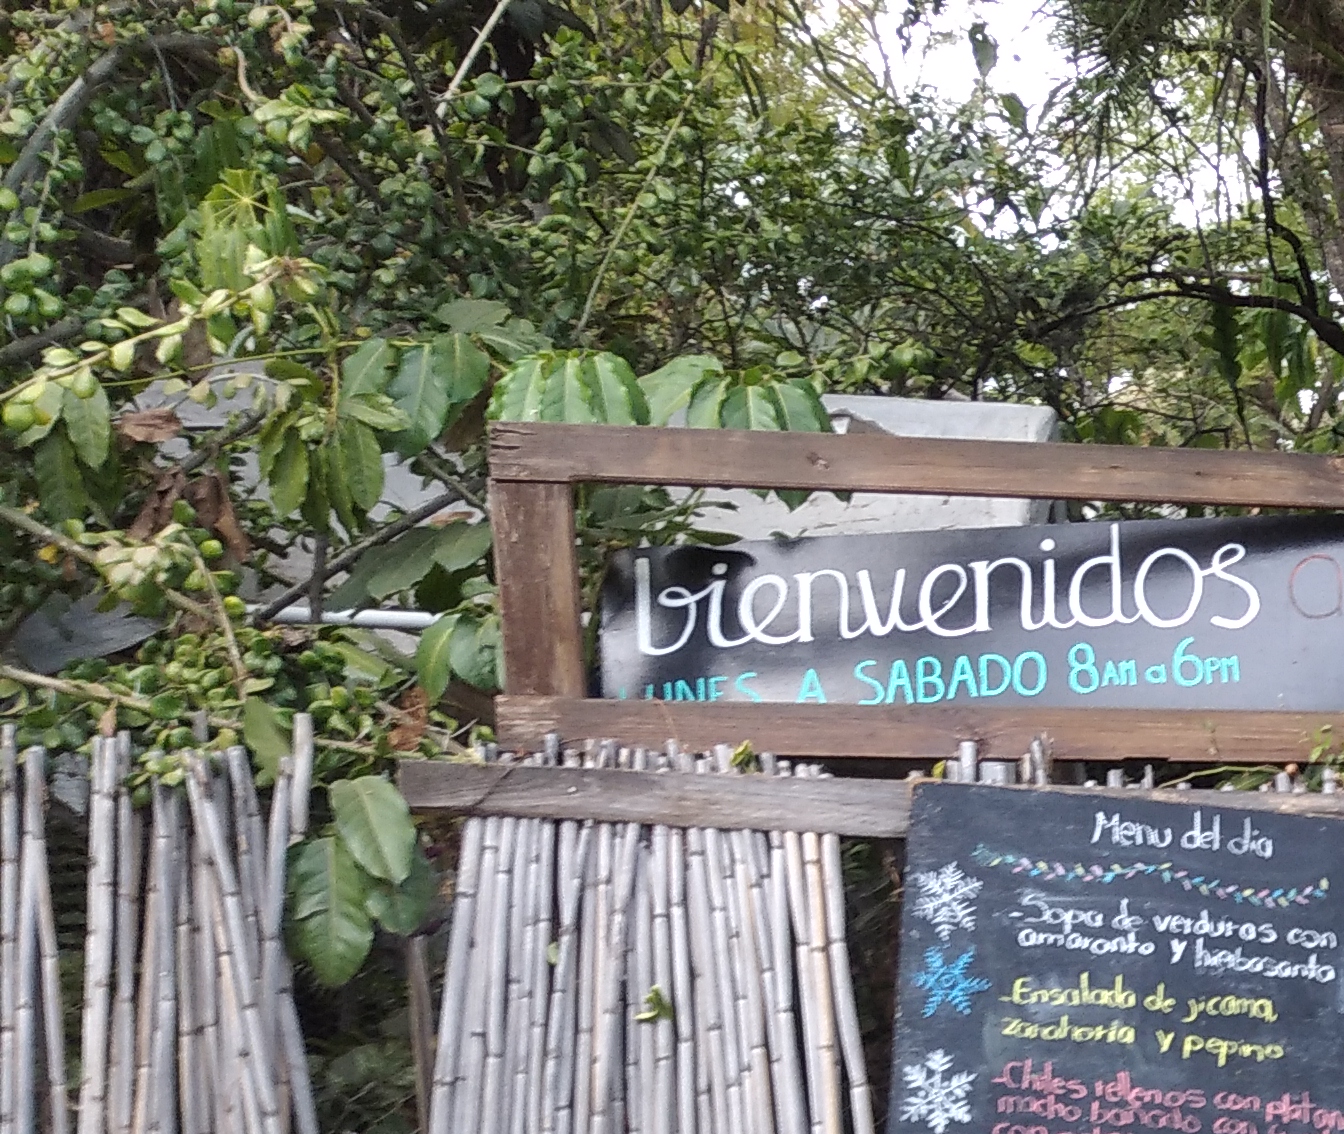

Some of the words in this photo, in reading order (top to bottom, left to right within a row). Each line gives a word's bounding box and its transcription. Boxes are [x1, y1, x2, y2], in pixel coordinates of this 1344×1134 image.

[795, 667, 827, 704] A
[853, 650, 1048, 706] SABADO
[1090, 811, 1172, 848] Menu
[1180, 810, 1221, 851] del
[1227, 816, 1273, 859] dia
[1111, 898, 1145, 931] de
[1152, 909, 1278, 943] verduras
[1286, 926, 1338, 949] con
[1143, 982, 1177, 1014] de
[1181, 1034, 1285, 1068] pepino
[1213, 1090, 1262, 1112] con
